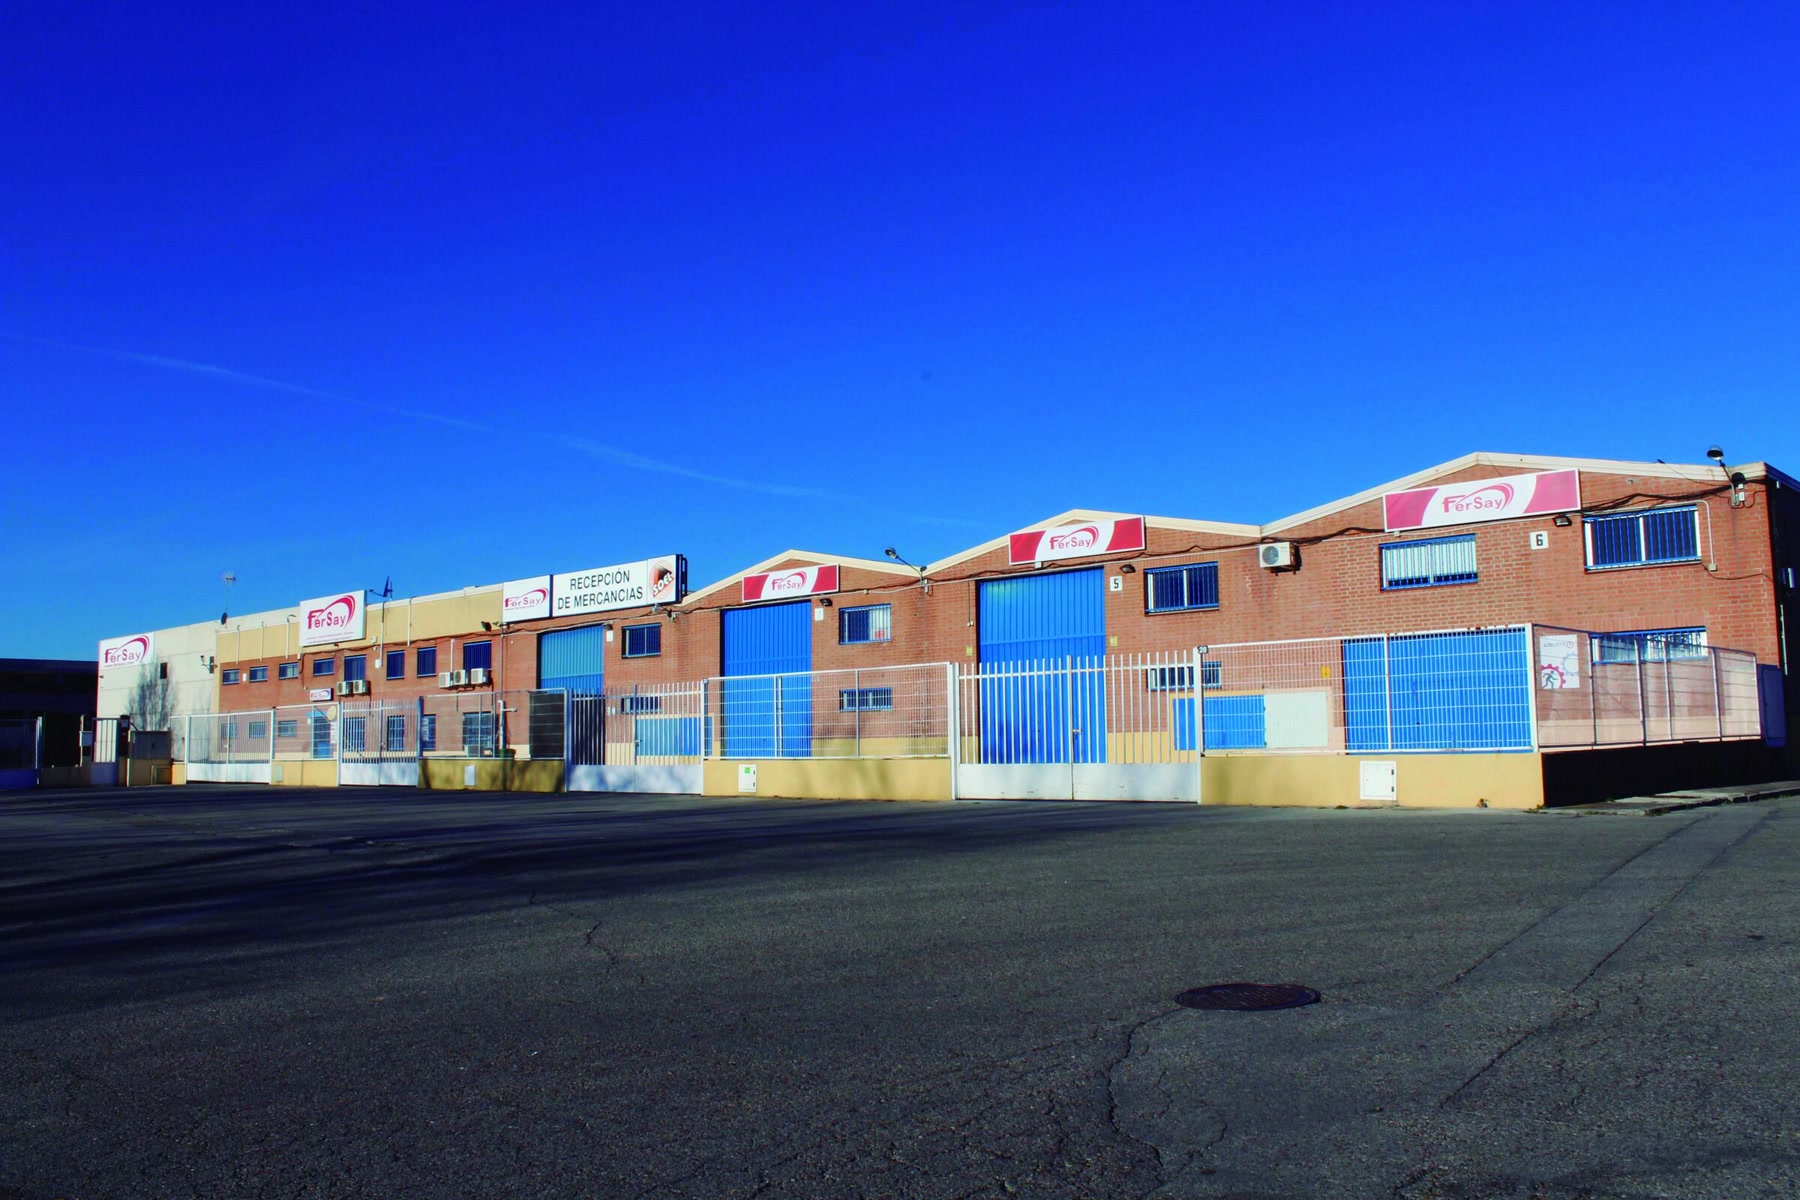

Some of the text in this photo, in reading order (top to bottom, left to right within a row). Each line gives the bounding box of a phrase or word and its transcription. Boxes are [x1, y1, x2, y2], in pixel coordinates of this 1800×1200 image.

[1442, 494, 1503, 512] FerSay
[1536, 533, 1543, 546] 6
[570, 568, 630, 590] RECEPCIÓN
[1113, 578, 1119, 589] 5
[557, 586, 643, 609] DE MERCANCIAS
